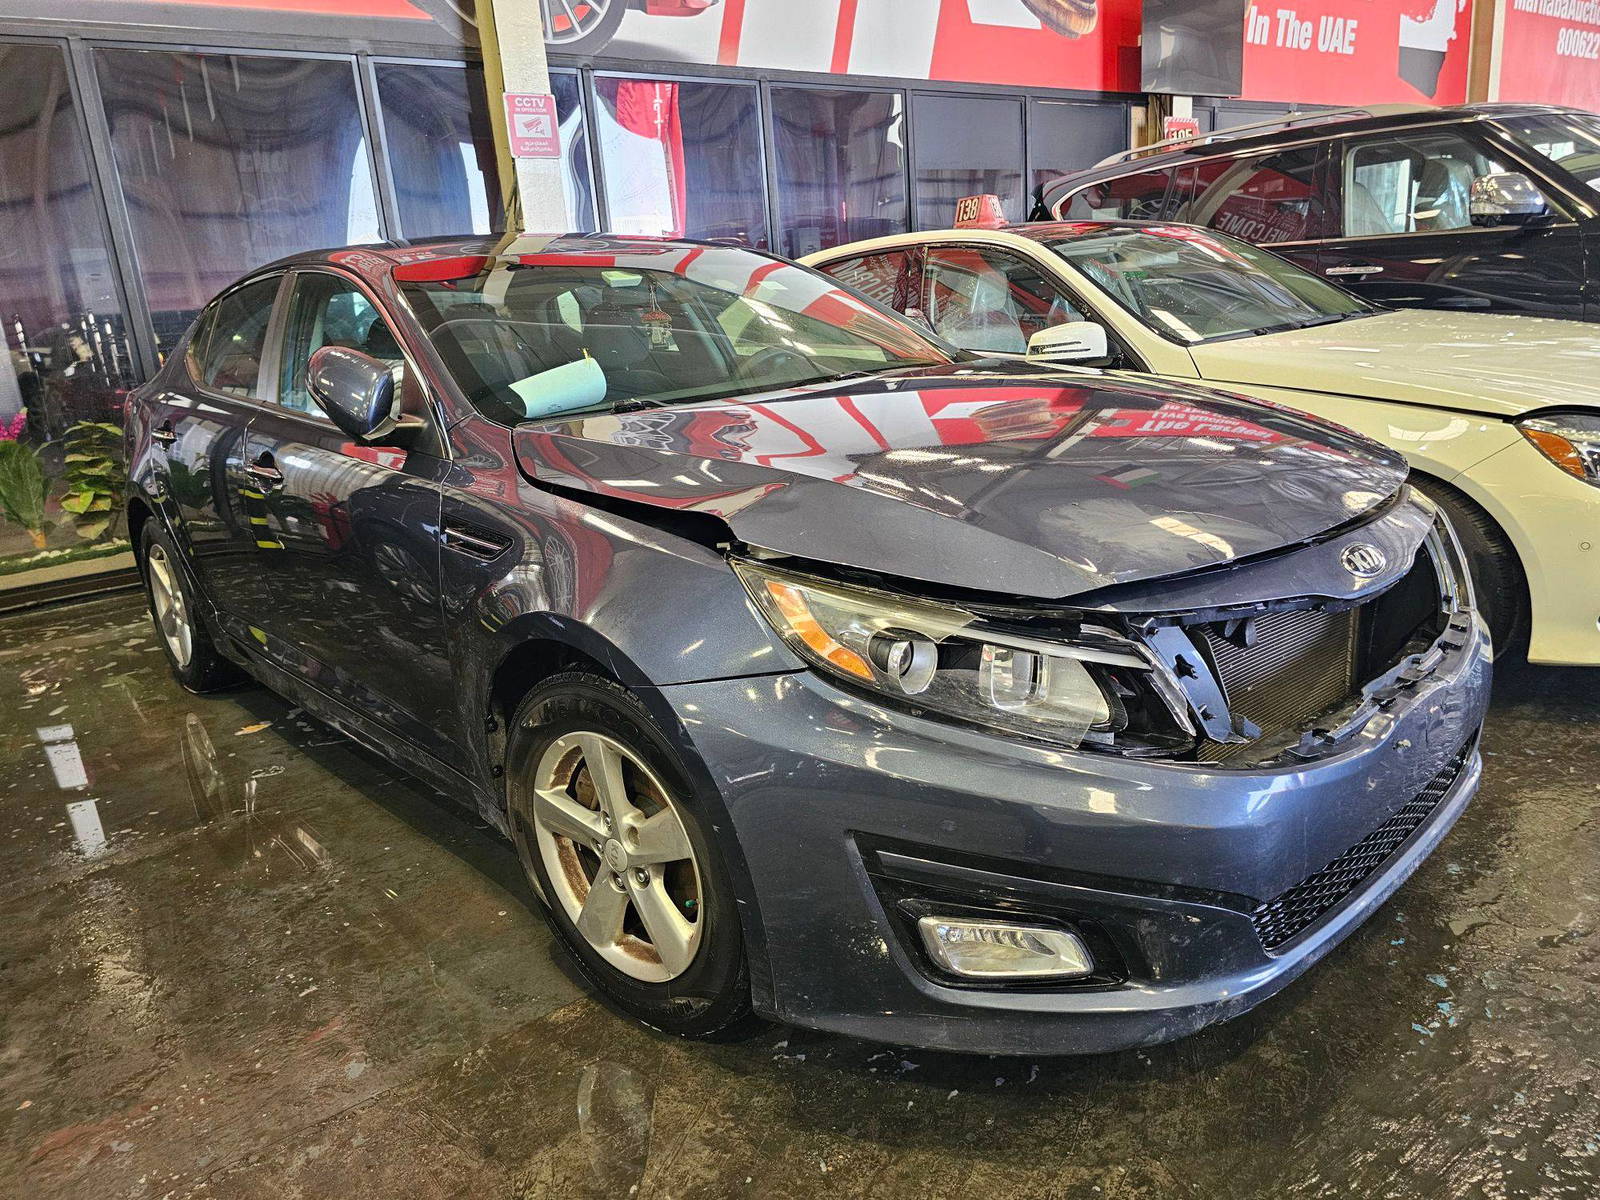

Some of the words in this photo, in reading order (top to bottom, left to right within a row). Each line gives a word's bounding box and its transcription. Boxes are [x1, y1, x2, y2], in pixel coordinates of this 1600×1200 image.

[1246, 5, 1270, 45] In
[1276, 8, 1313, 51] The
[1317, 15, 1358, 55] UAE
[1556, 27, 1600, 59] 800622
[514, 97, 545, 107] CCTV
[958, 198, 979, 222] 138
